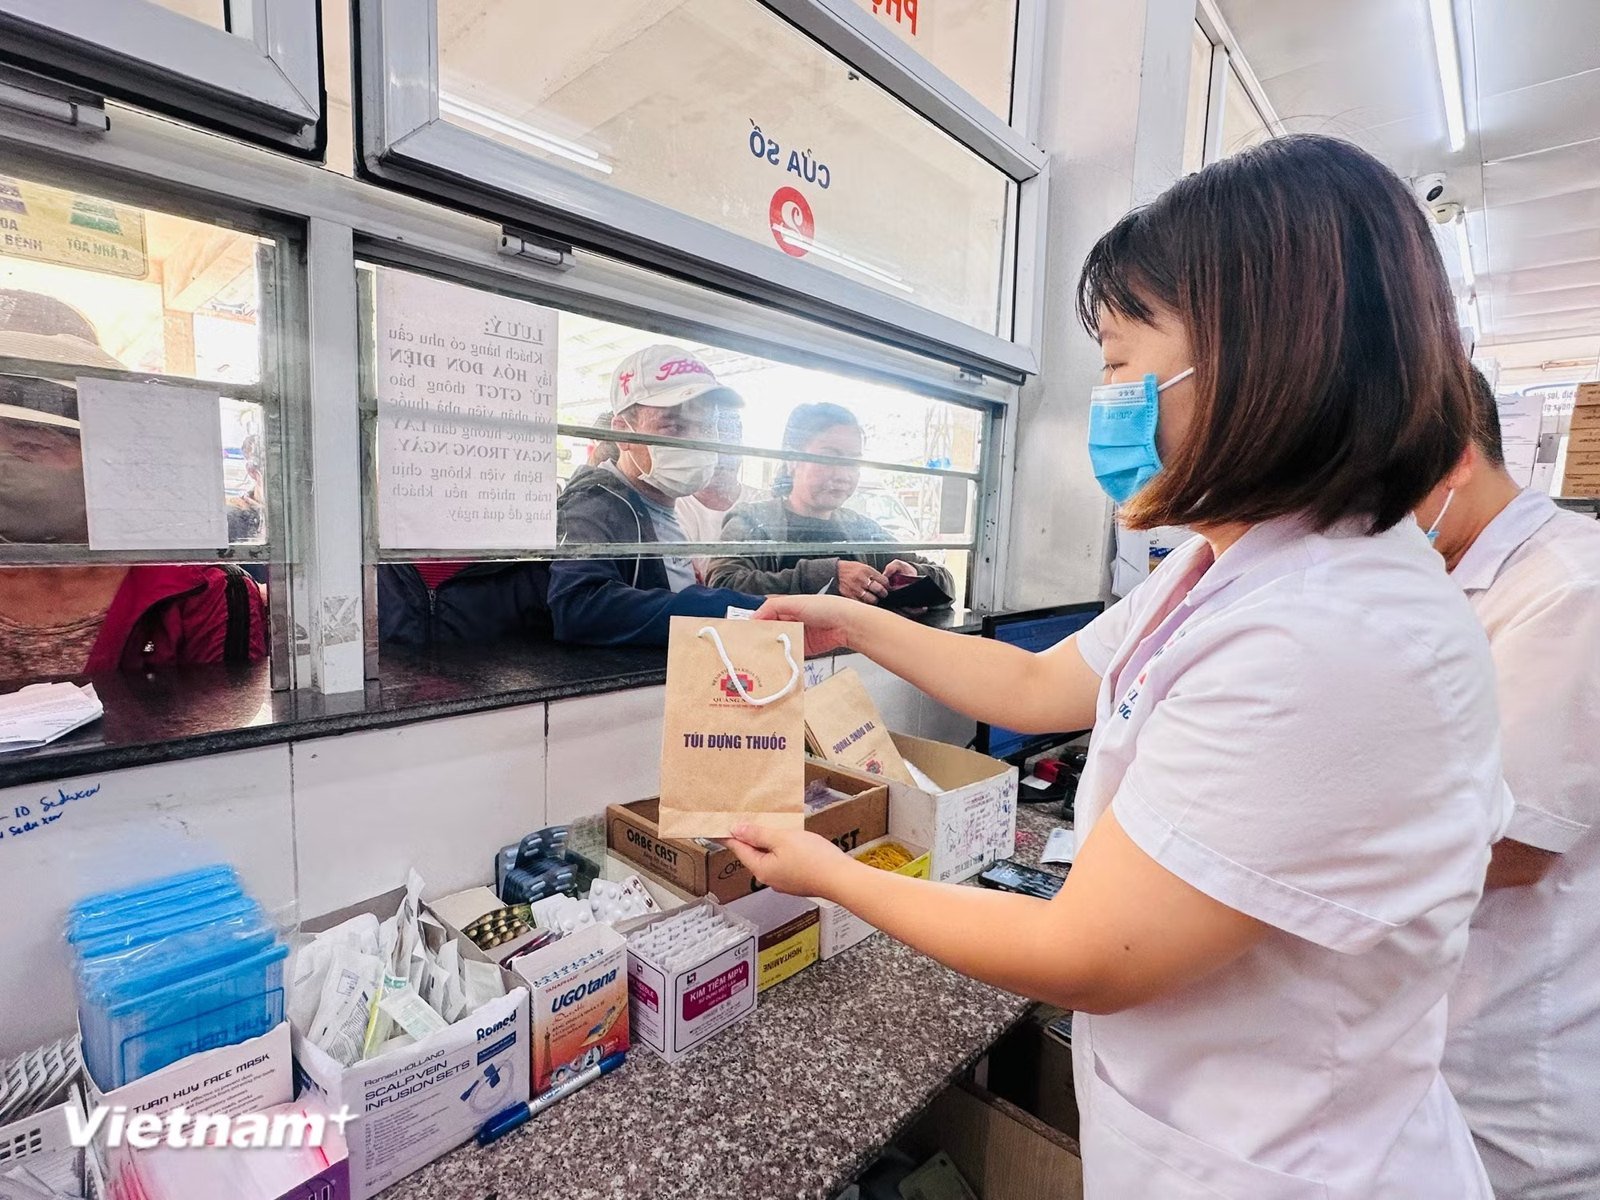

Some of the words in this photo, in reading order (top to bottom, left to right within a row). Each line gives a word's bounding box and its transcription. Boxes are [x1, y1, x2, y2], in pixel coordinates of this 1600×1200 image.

[683, 732, 704, 748] TÚI
[707, 733, 742, 751] ĐỰNG
[745, 732, 787, 750] THUỐC
[626, 829, 653, 852] ORBE
[654, 842, 679, 866] CAST
[690, 987, 706, 1002] KIM
[708, 977, 727, 994] TIÊM
[727, 965, 744, 981] MPV
[476, 1009, 517, 1041] Romed
[133, 1095, 169, 1114] TUAN
[173, 1082, 200, 1099] HUY
[203, 1069, 232, 1087] FACE
[236, 1053, 270, 1073] MASK
[364, 1069, 398, 1087] Romed
[399, 1049, 445, 1075] HOLLAND
[365, 1075, 415, 1100] SCALP
[415, 1060, 448, 1079] VEIN
[365, 1078, 434, 1112] INFUSION
[436, 1060, 470, 1082] SETS
